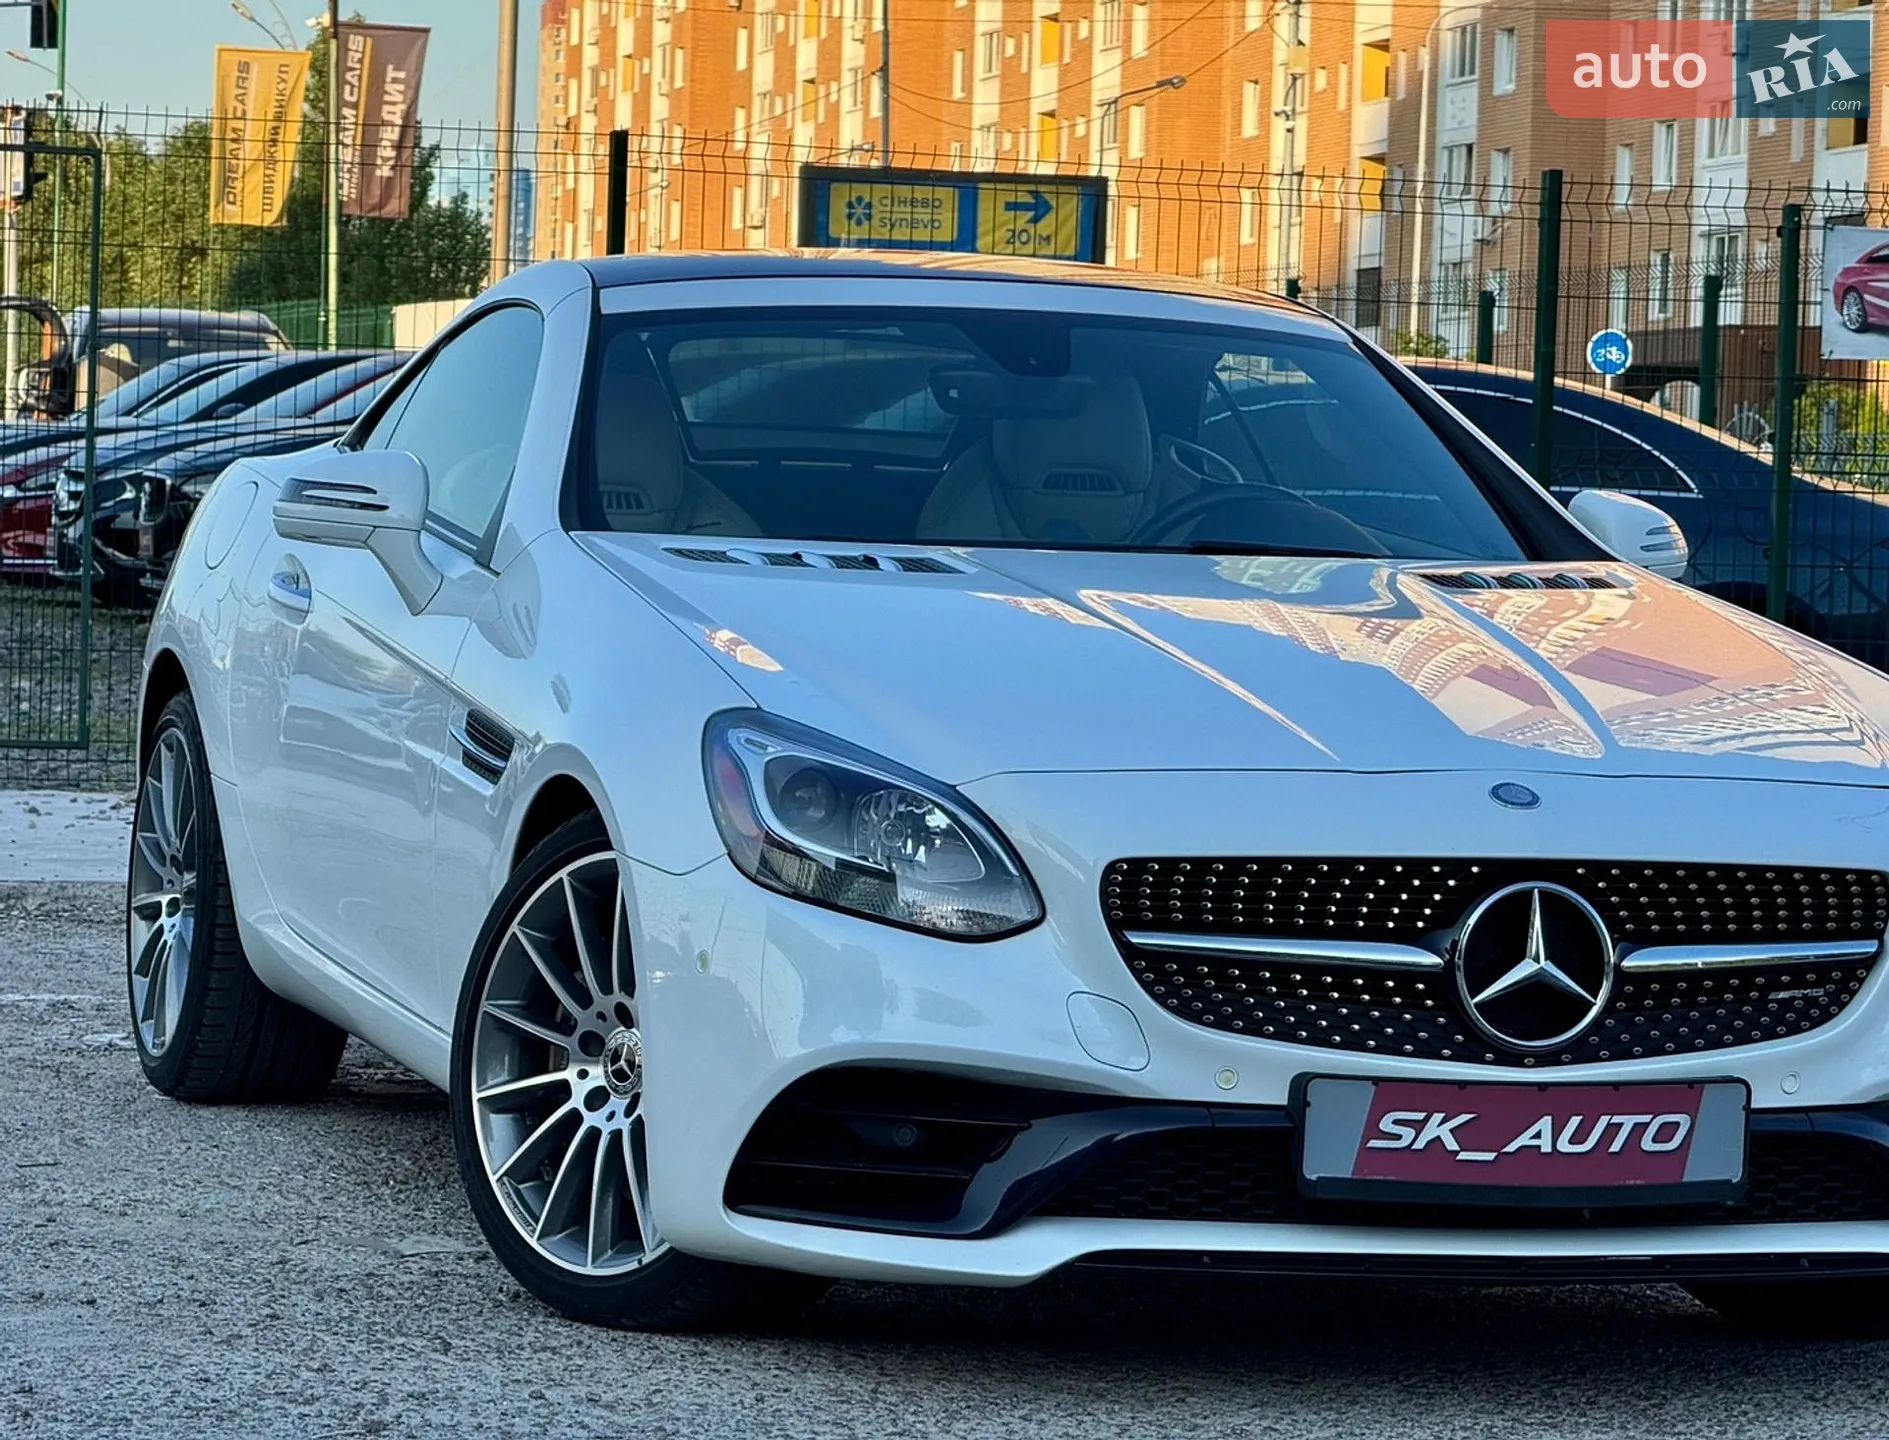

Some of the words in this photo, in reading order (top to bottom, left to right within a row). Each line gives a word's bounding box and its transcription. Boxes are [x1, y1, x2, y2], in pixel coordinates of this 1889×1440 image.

[233, 60, 251, 120] CARS
[343, 34, 365, 102] CARS
[263, 125, 281, 213] ШВИДКИЙ
[273, 63, 290, 122] ВИКУП
[339, 109, 357, 196] DREAM
[375, 64, 407, 177] КРЕДИТ
[226, 126, 243, 206] DREAM
[879, 215, 943, 232] synevo
[1005, 228, 1031, 245] 20
[1365, 1111, 1692, 1161] SK_AUTO
